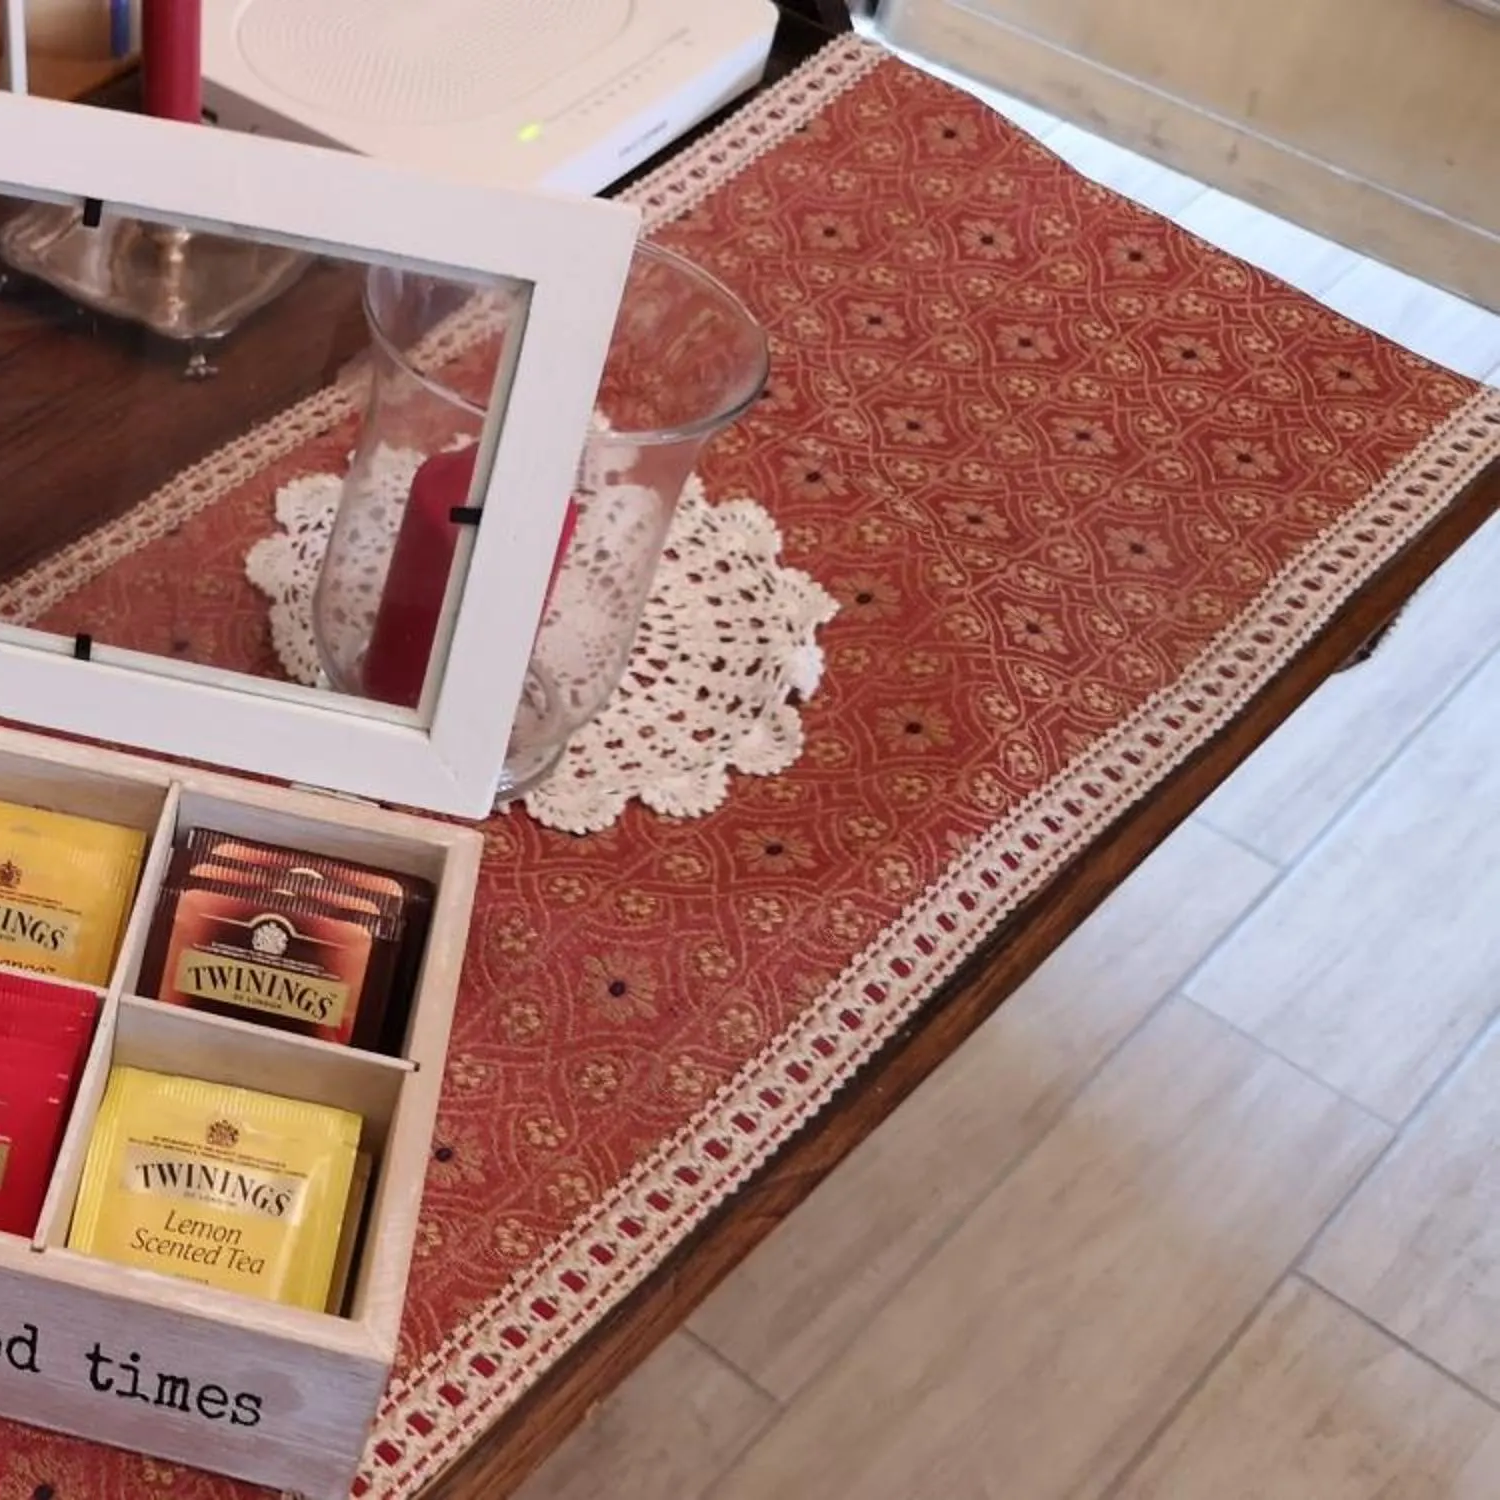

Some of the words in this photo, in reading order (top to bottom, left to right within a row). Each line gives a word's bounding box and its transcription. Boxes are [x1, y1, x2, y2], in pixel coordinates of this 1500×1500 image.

[188, 964, 333, 1020] TWININGS
[135, 1161, 291, 1217] TWININGS
[130, 1228, 222, 1266] Scented
[226, 1248, 265, 1276] Tea
[164, 1209, 242, 1246] Lemon
[85, 1341, 264, 1428] times
